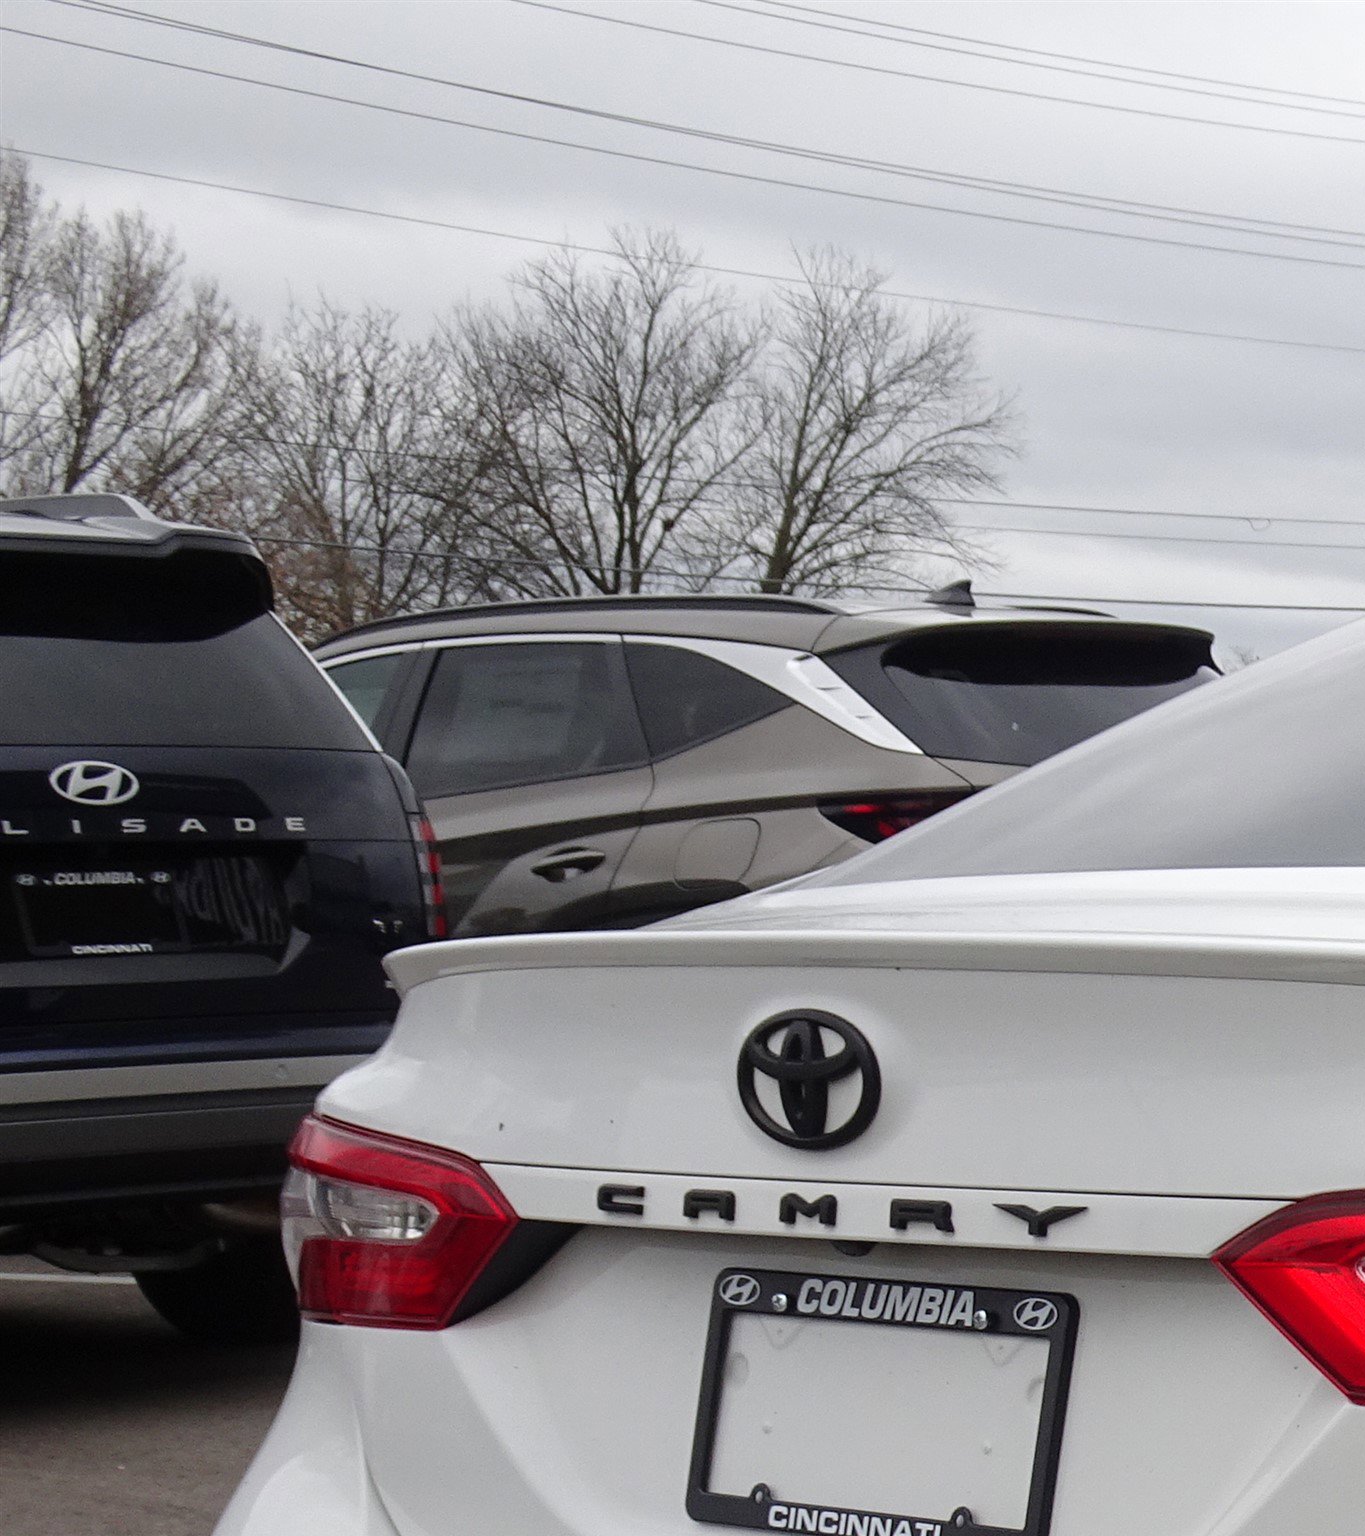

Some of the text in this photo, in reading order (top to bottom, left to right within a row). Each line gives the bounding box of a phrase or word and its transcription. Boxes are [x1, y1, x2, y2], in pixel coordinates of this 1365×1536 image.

[1, 817, 307, 835] LISADE
[54, 872, 136, 885] COLUMBIA
[71, 943, 153, 955] CINCINNATI
[597, 1183, 1089, 1238] CAMRY
[796, 1278, 975, 1328] COLUMBIA
